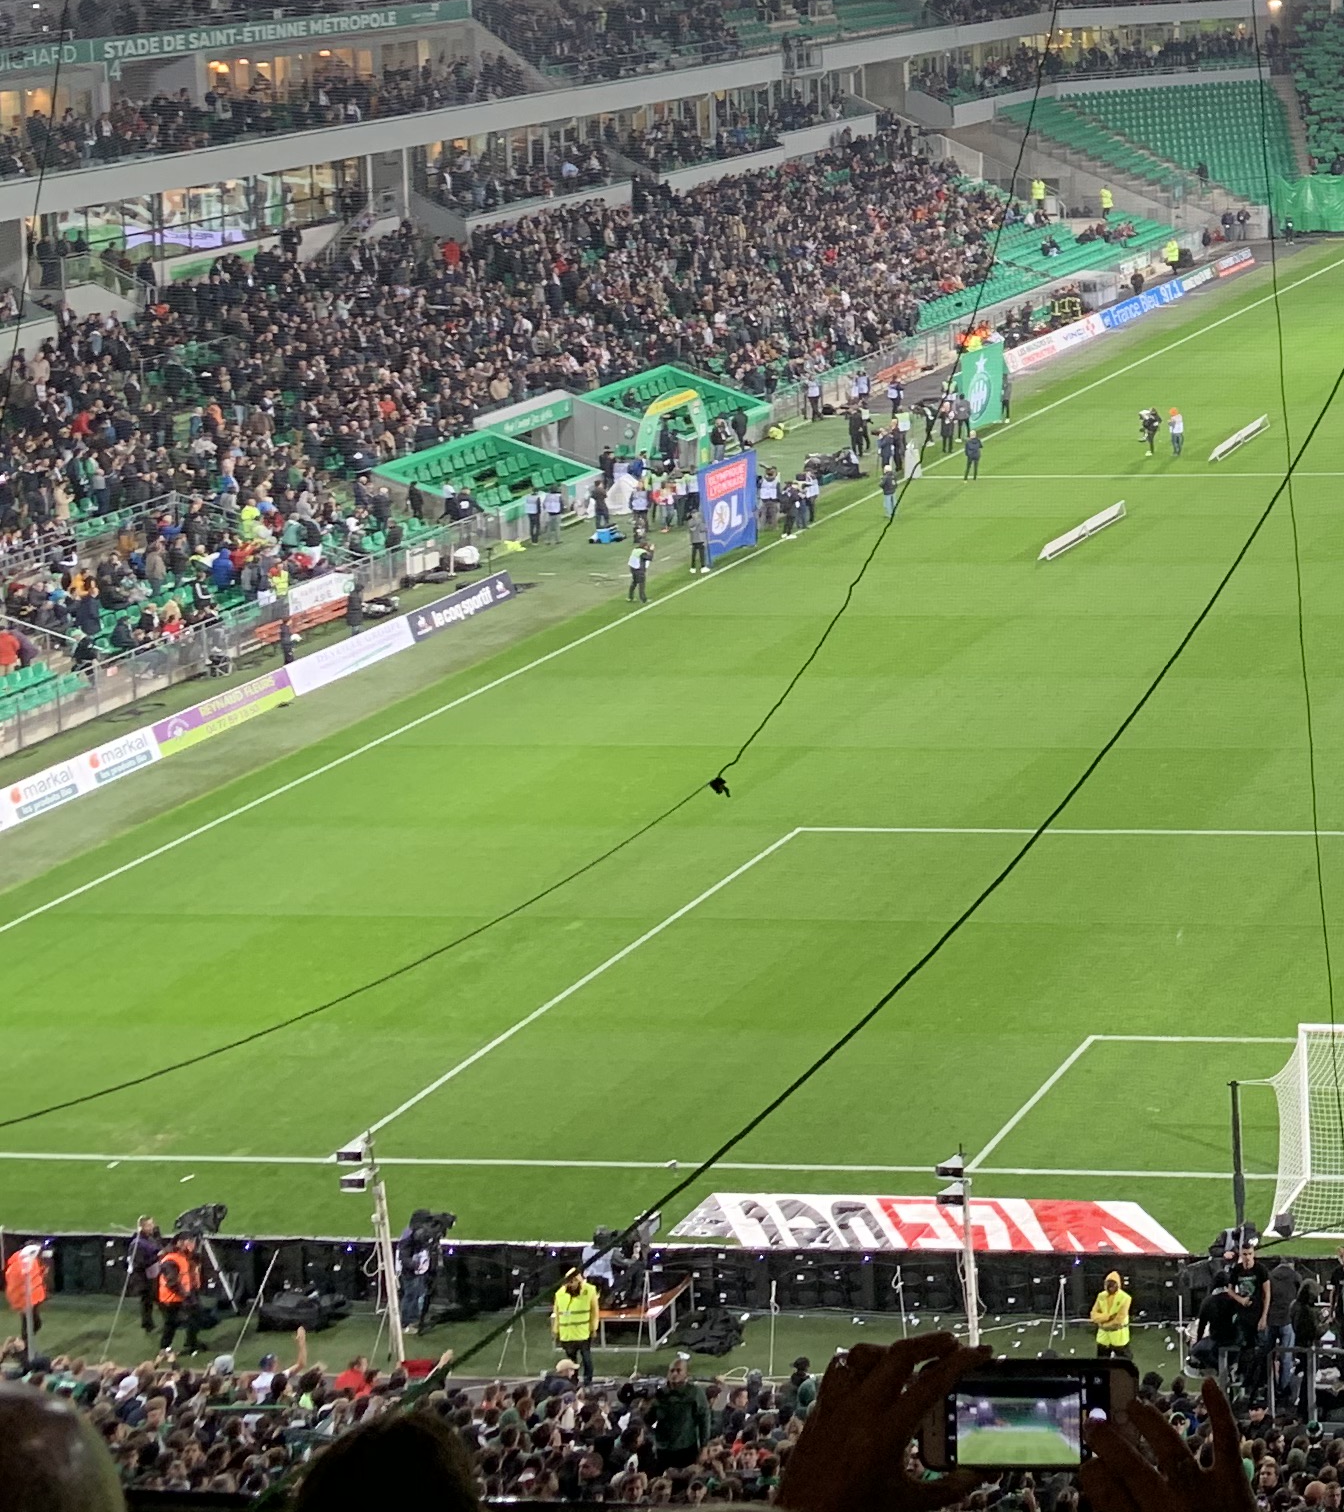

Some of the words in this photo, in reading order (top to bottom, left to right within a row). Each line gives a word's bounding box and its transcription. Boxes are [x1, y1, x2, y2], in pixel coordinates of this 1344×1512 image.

[104, 38, 160, 59] STADE
[163, 36, 185, 53] DE
[189, 21, 308, 49] SAINT-ÉTIENNE
[309, 11, 397, 36] MÉTROPOLE
[1112, 300, 1142, 326] France
[1141, 291, 1160, 313] Bleu
[1161, 278, 1184, 303] 97.1
[712, 494, 742, 535] OL
[431, 609, 444, 628] le
[444, 600, 463, 621] coq
[462, 586, 494, 616] sportif
[101, 734, 149, 764] markal
[22, 766, 74, 799] markal
